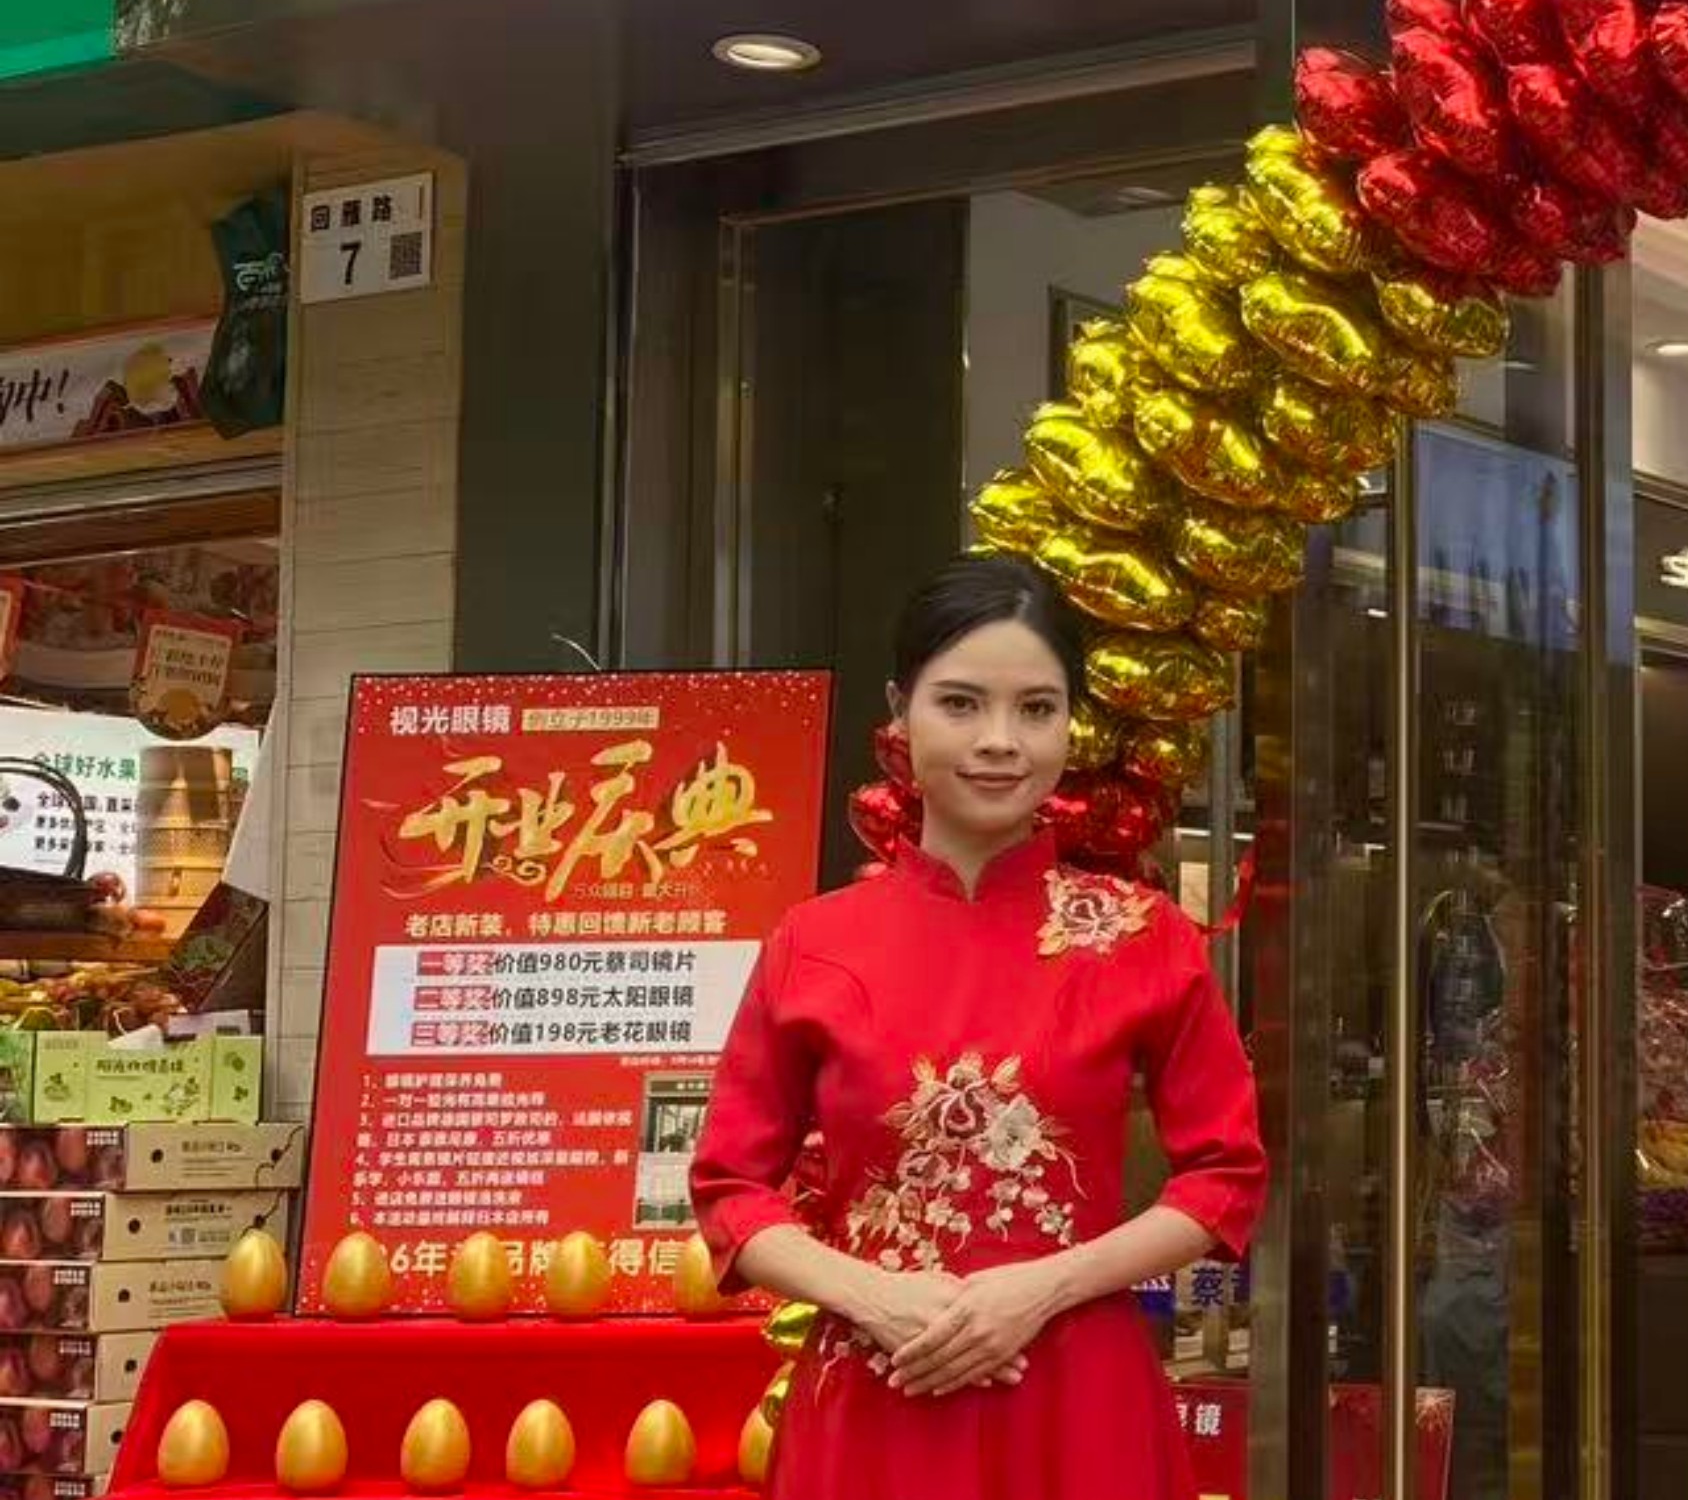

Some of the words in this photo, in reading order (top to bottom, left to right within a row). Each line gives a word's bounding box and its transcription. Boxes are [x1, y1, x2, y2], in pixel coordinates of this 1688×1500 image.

[340, 241, 362, 285] 7
[389, 704, 512, 735] 视光眼镜
[399, 739, 774, 902] 开业庆典
